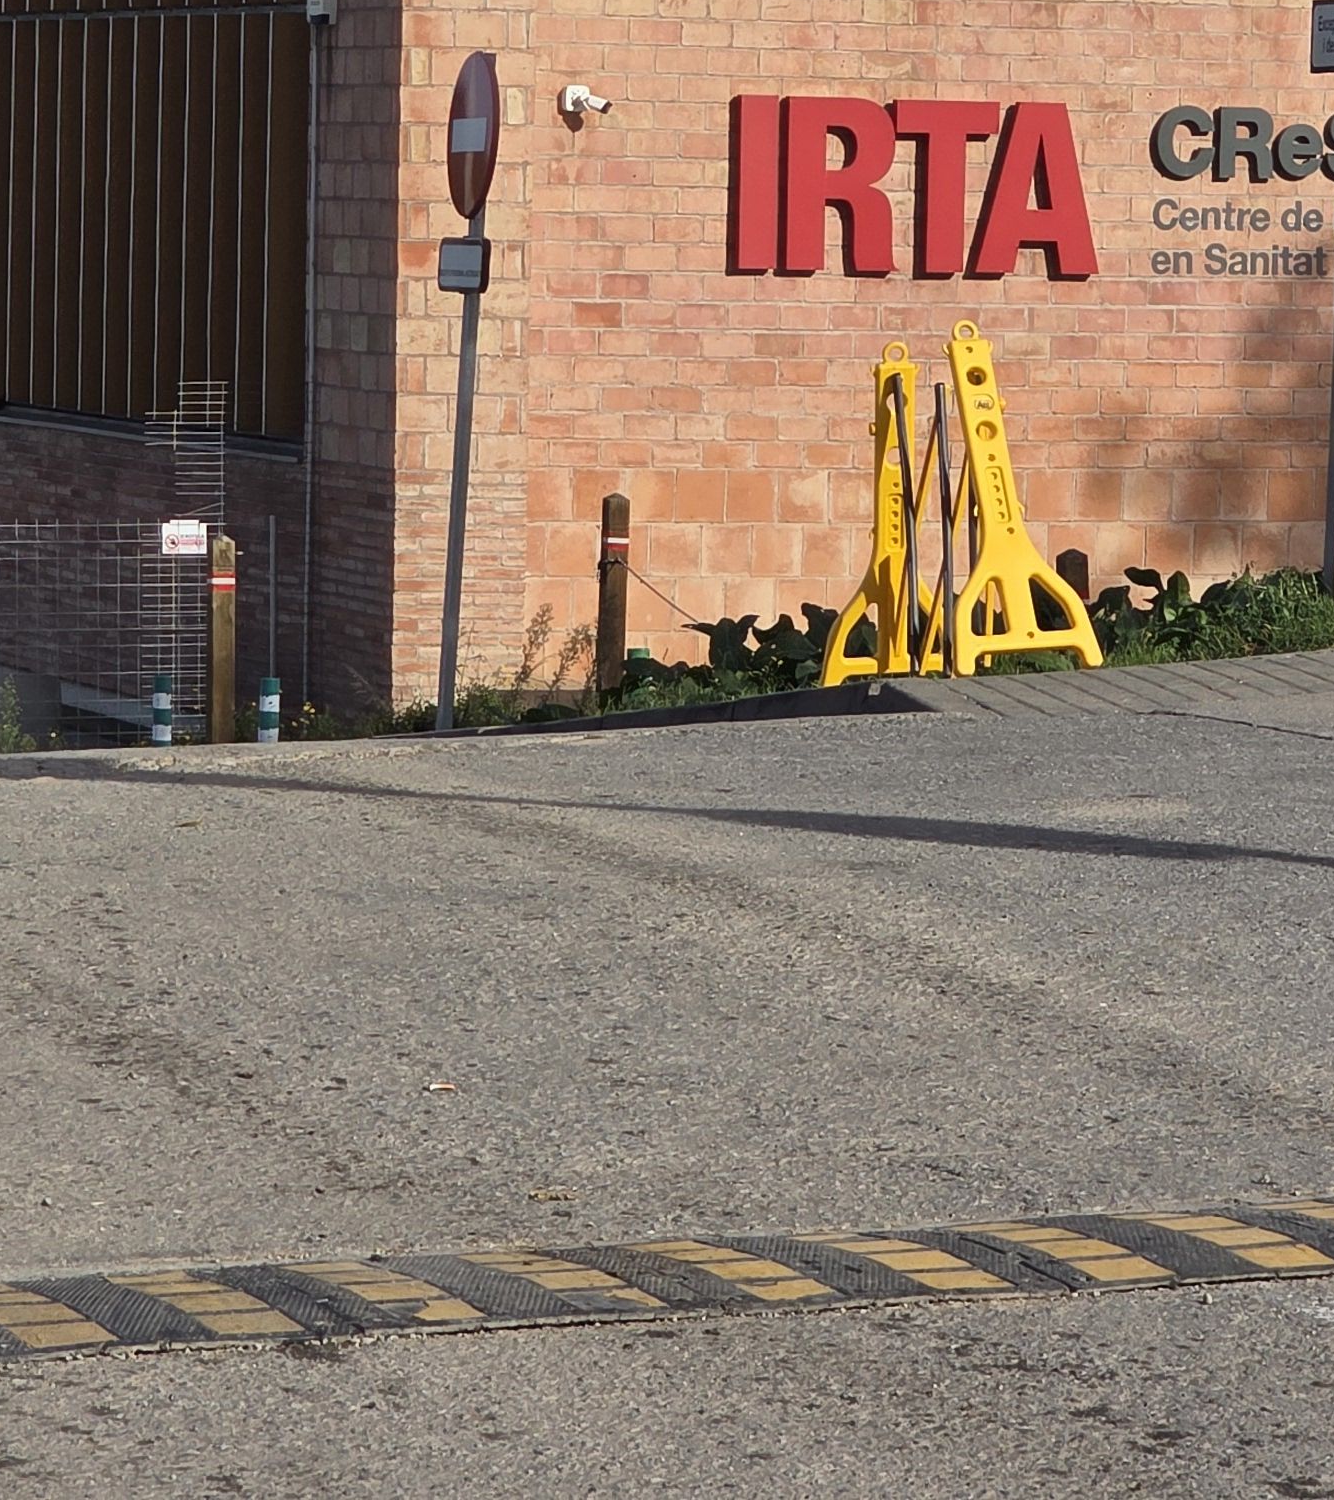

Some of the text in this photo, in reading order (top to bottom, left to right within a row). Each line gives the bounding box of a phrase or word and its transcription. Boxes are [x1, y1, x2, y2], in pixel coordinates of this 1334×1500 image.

[729, 95, 1099, 280] IRTA
[1152, 198, 1270, 232] Centre
[1281, 200, 1324, 231] de
[1151, 250, 1193, 275] en
[1204, 243, 1328, 276] Sanitat
